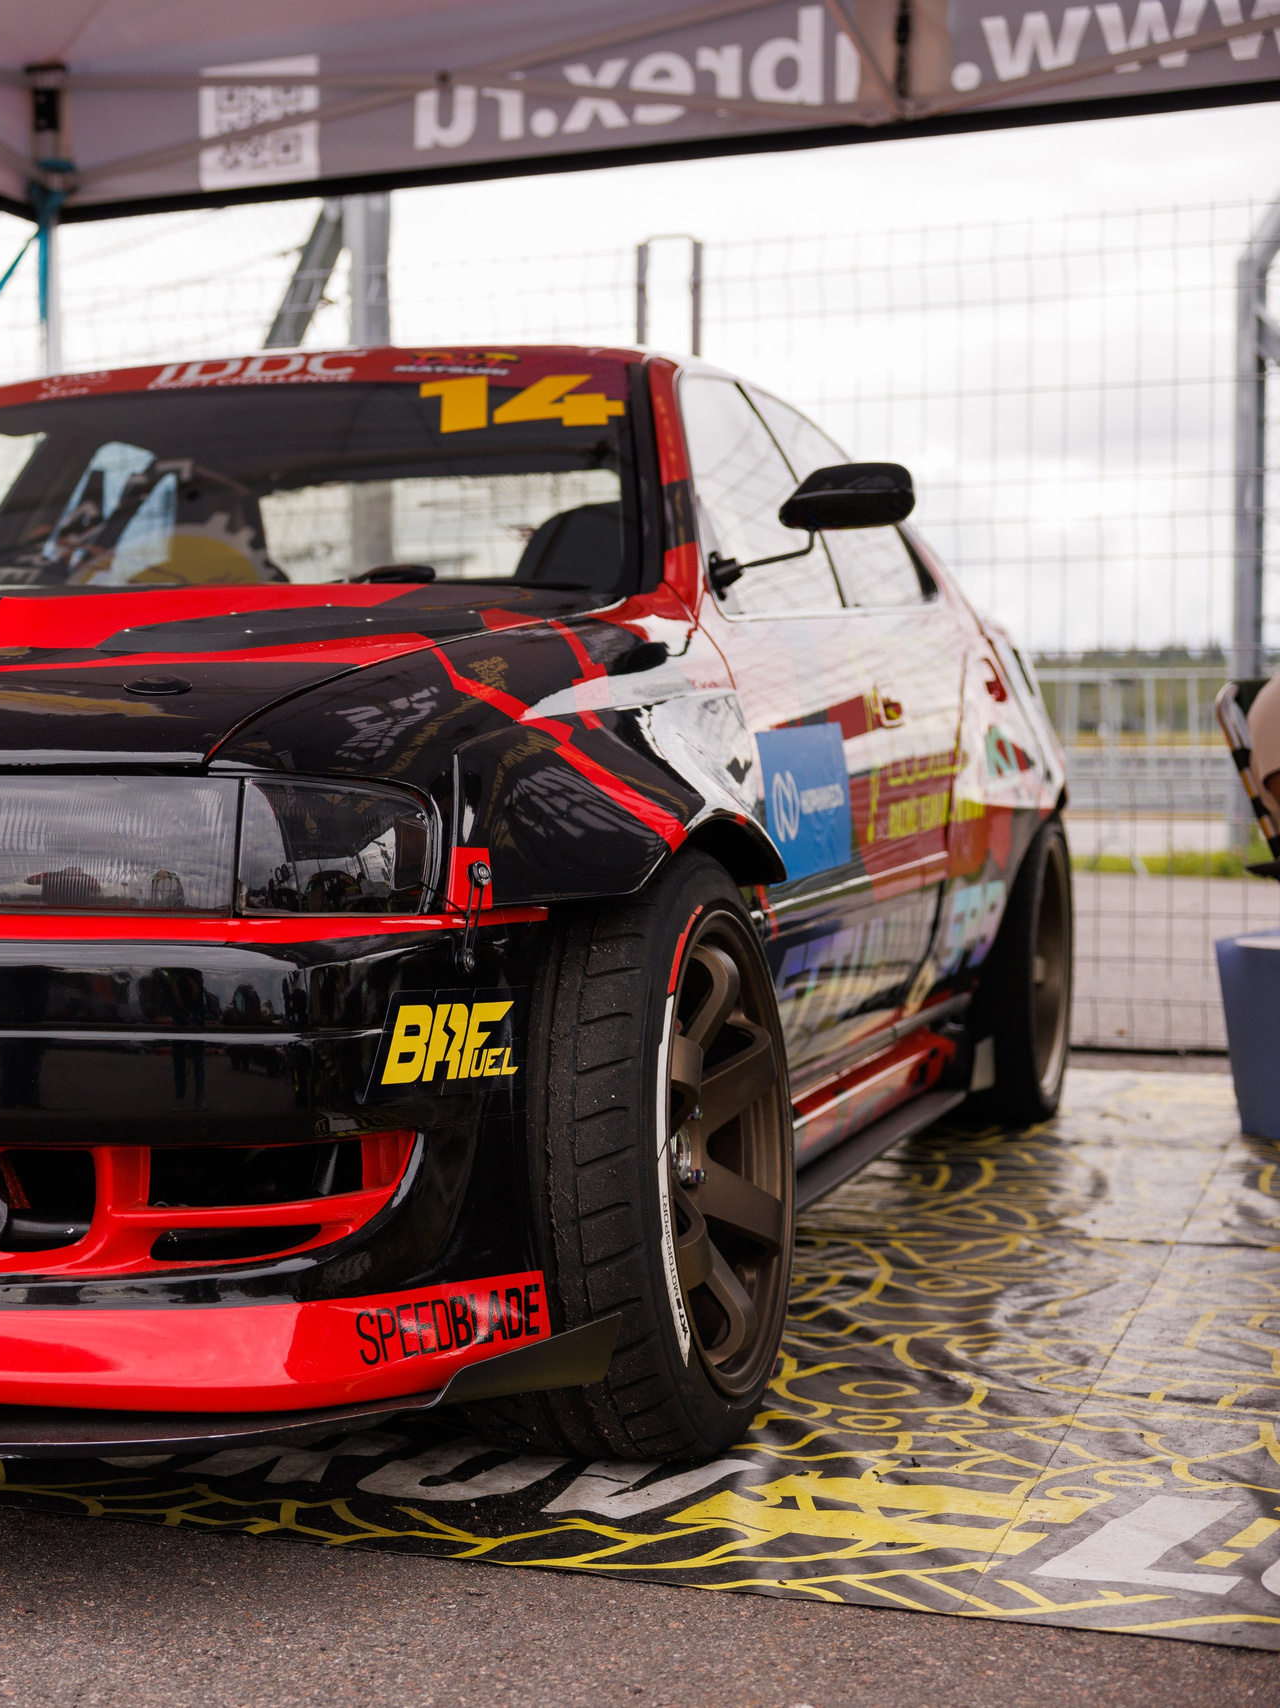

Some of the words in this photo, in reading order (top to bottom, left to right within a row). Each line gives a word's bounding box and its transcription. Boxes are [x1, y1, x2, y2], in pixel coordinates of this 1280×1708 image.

[420, 374, 626, 434] 14
[662, 1193, 680, 1297] MOTORSPORT
[355, 1283, 541, 1367] SPEEDBLADE
